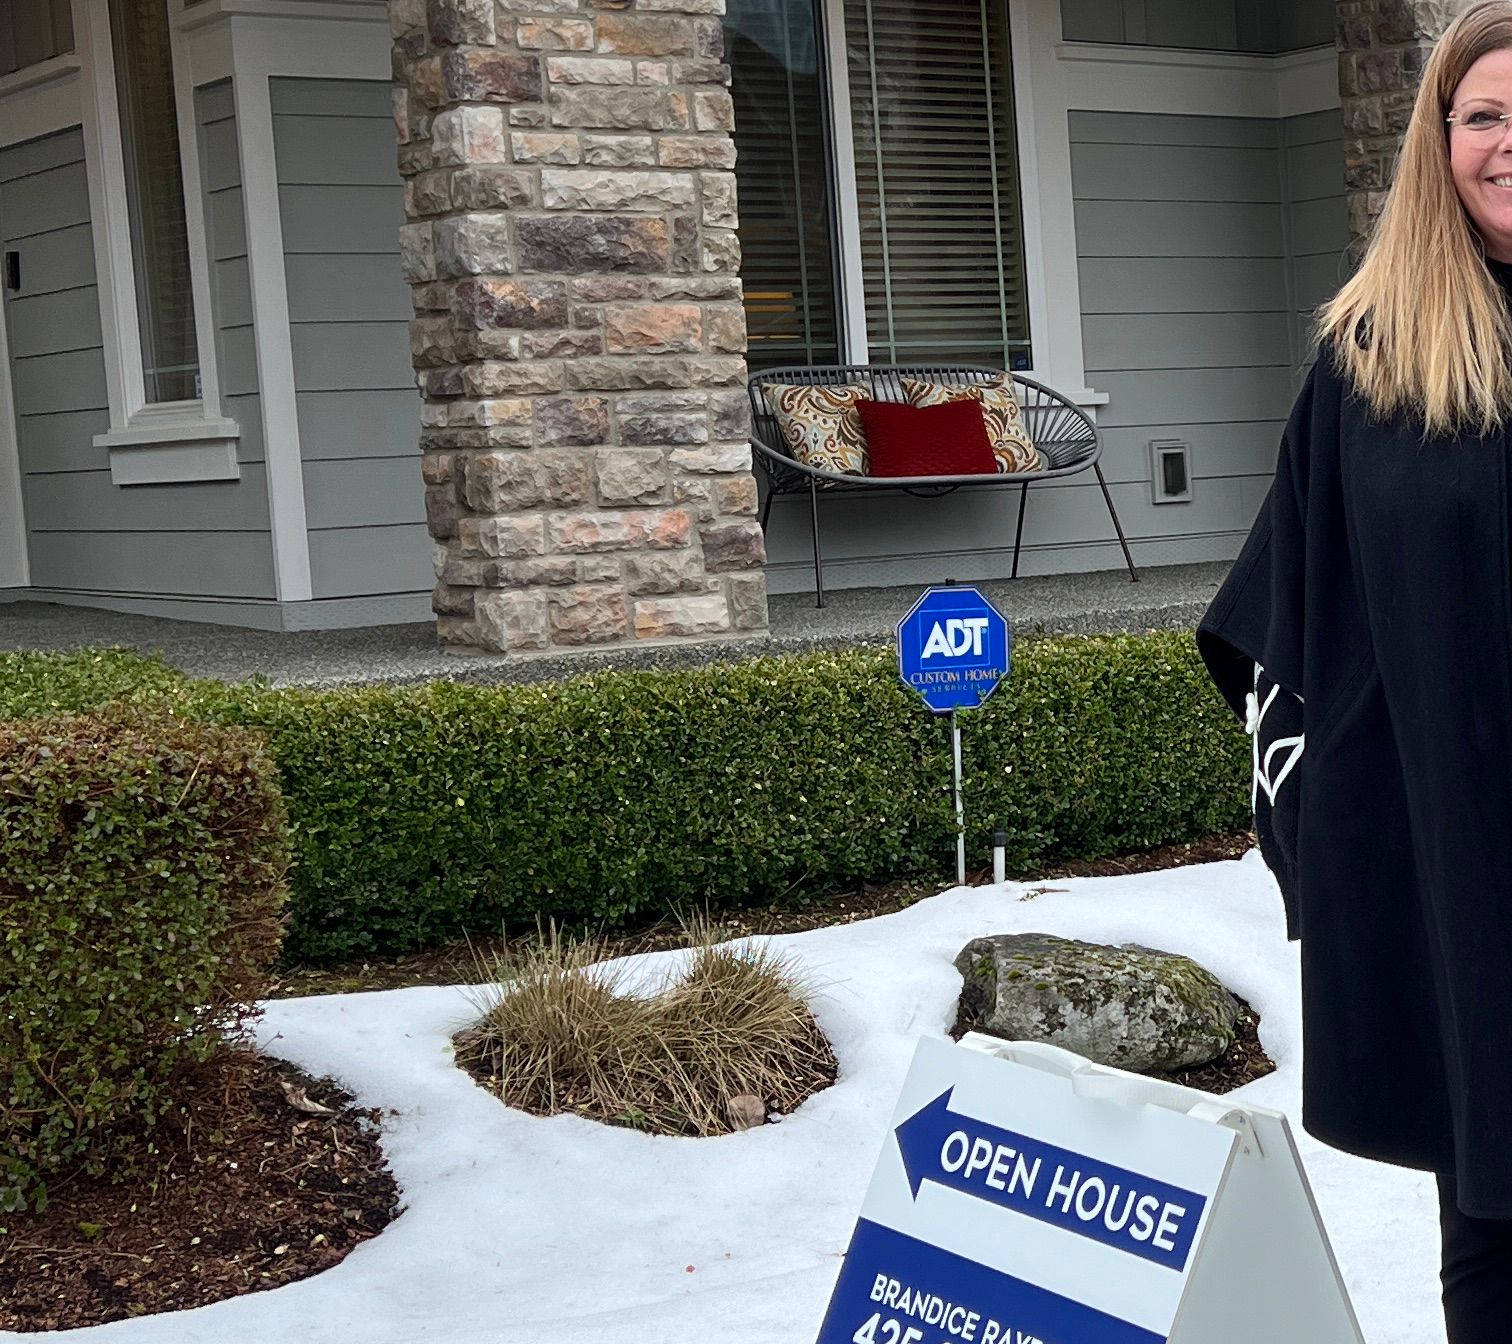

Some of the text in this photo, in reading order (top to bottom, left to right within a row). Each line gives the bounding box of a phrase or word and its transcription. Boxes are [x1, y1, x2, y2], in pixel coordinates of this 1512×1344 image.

[921, 617, 989, 659] ADT
[910, 668, 998, 685] CUSTOM HOME
[941, 1130, 1186, 1251] OPEN HOUSE
[870, 1273, 980, 1341] BRANDICE
